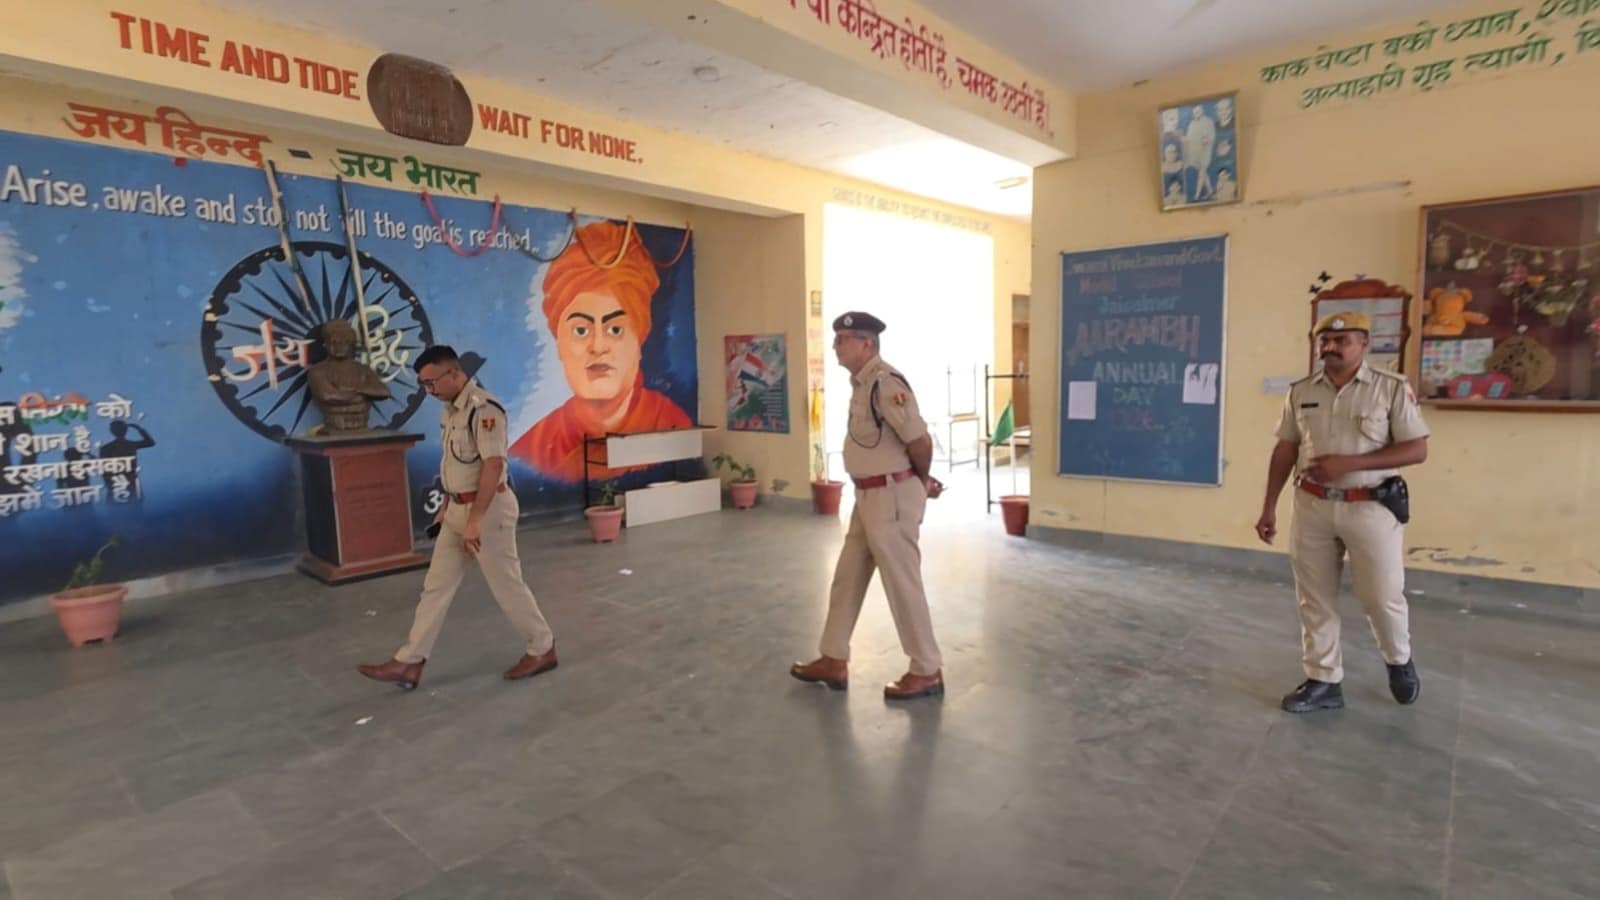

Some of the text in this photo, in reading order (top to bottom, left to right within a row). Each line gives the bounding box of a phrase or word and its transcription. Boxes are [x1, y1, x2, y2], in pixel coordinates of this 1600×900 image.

[110, 11, 361, 100] TIME AND TIDE
[838, 0, 898, 59] कन्द्रित
[956, 56, 999, 104] चमक
[1261, 57, 1311, 83] काक
[1314, 44, 1375, 70] चेष्टा
[1414, 58, 1456, 91] गृह
[61, 101, 152, 146] जय
[153, 105, 272, 169] हिन्द
[329, 148, 399, 182] जय
[404, 155, 481, 195] भारत
[477, 104, 643, 164] WAIT FOR NONE.
[103, 184, 187, 217] awake
[195, 194, 236, 224] and
[242, 197, 289, 228] sto
[296, 204, 331, 232] not
[338, 207, 367, 237] ill
[373, 210, 406, 240] the
[448, 219, 463, 246] is
[1092, 361, 1184, 384] ANNUAL
[15, 433, 69, 456] शान
[50, 485, 104, 509] जान
